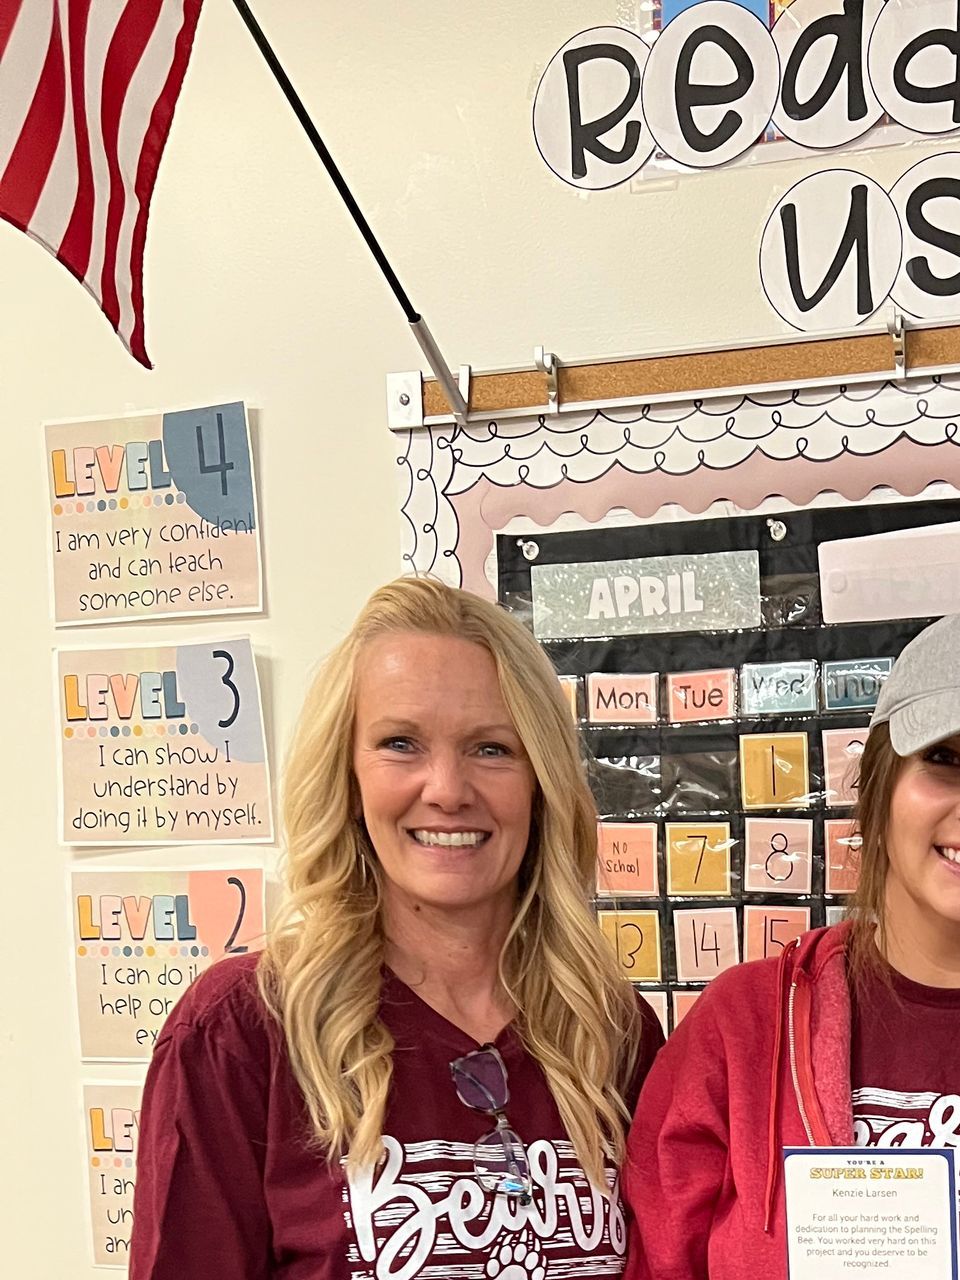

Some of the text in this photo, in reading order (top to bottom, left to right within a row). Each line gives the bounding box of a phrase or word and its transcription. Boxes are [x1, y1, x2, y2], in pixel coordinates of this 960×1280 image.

[51, 439, 171, 499] LEVEL
[195, 412, 235, 496] 4
[54, 513, 254, 554] I am very confident
[88, 548, 223, 580] and can teach
[78, 580, 235, 612] someone else.
[584, 571, 704, 621] APRIL
[63, 670, 186, 722] LEVEL
[212, 649, 241, 729] 3
[596, 685, 649, 710] Mon
[679, 685, 724, 710] Tue
[752, 672, 805, 697] Wed
[99, 739, 232, 767] I can show I
[92, 771, 239, 799] understand by
[71, 801, 262, 834] doing it by myself.
[605, 858, 640, 878] School
[686, 834, 709, 885] 7
[764, 832, 794, 882] 8
[77, 894, 197, 941] LEVEL
[223, 876, 249, 954] 2
[614, 921, 644, 969] 13
[692, 918, 721, 968] 14
[101, 963, 108, 985] I
[114, 966, 151, 985] can
[157, 963, 183, 985] do
[99, 993, 142, 1019] help
[100, 1173, 107, 1195] I
[809, 1167, 924, 1180] SUPER STAR!
[832, 1188, 898, 1198] Kenzie Larsen
[795, 1224, 938, 1236] dedication to planning the Spelling
[812, 1213, 920, 1224] For all your hard work and
[797, 1236, 816, 1245] Bee.
[817, 1236, 834, 1245] You
[835, 1236, 867, 1246] worked
[868, 1238, 885, 1246] very
[886, 1236, 906, 1245] hard
[920, 1236, 937, 1245] this
[806, 1247, 928, 1258] project and you deserve to be
